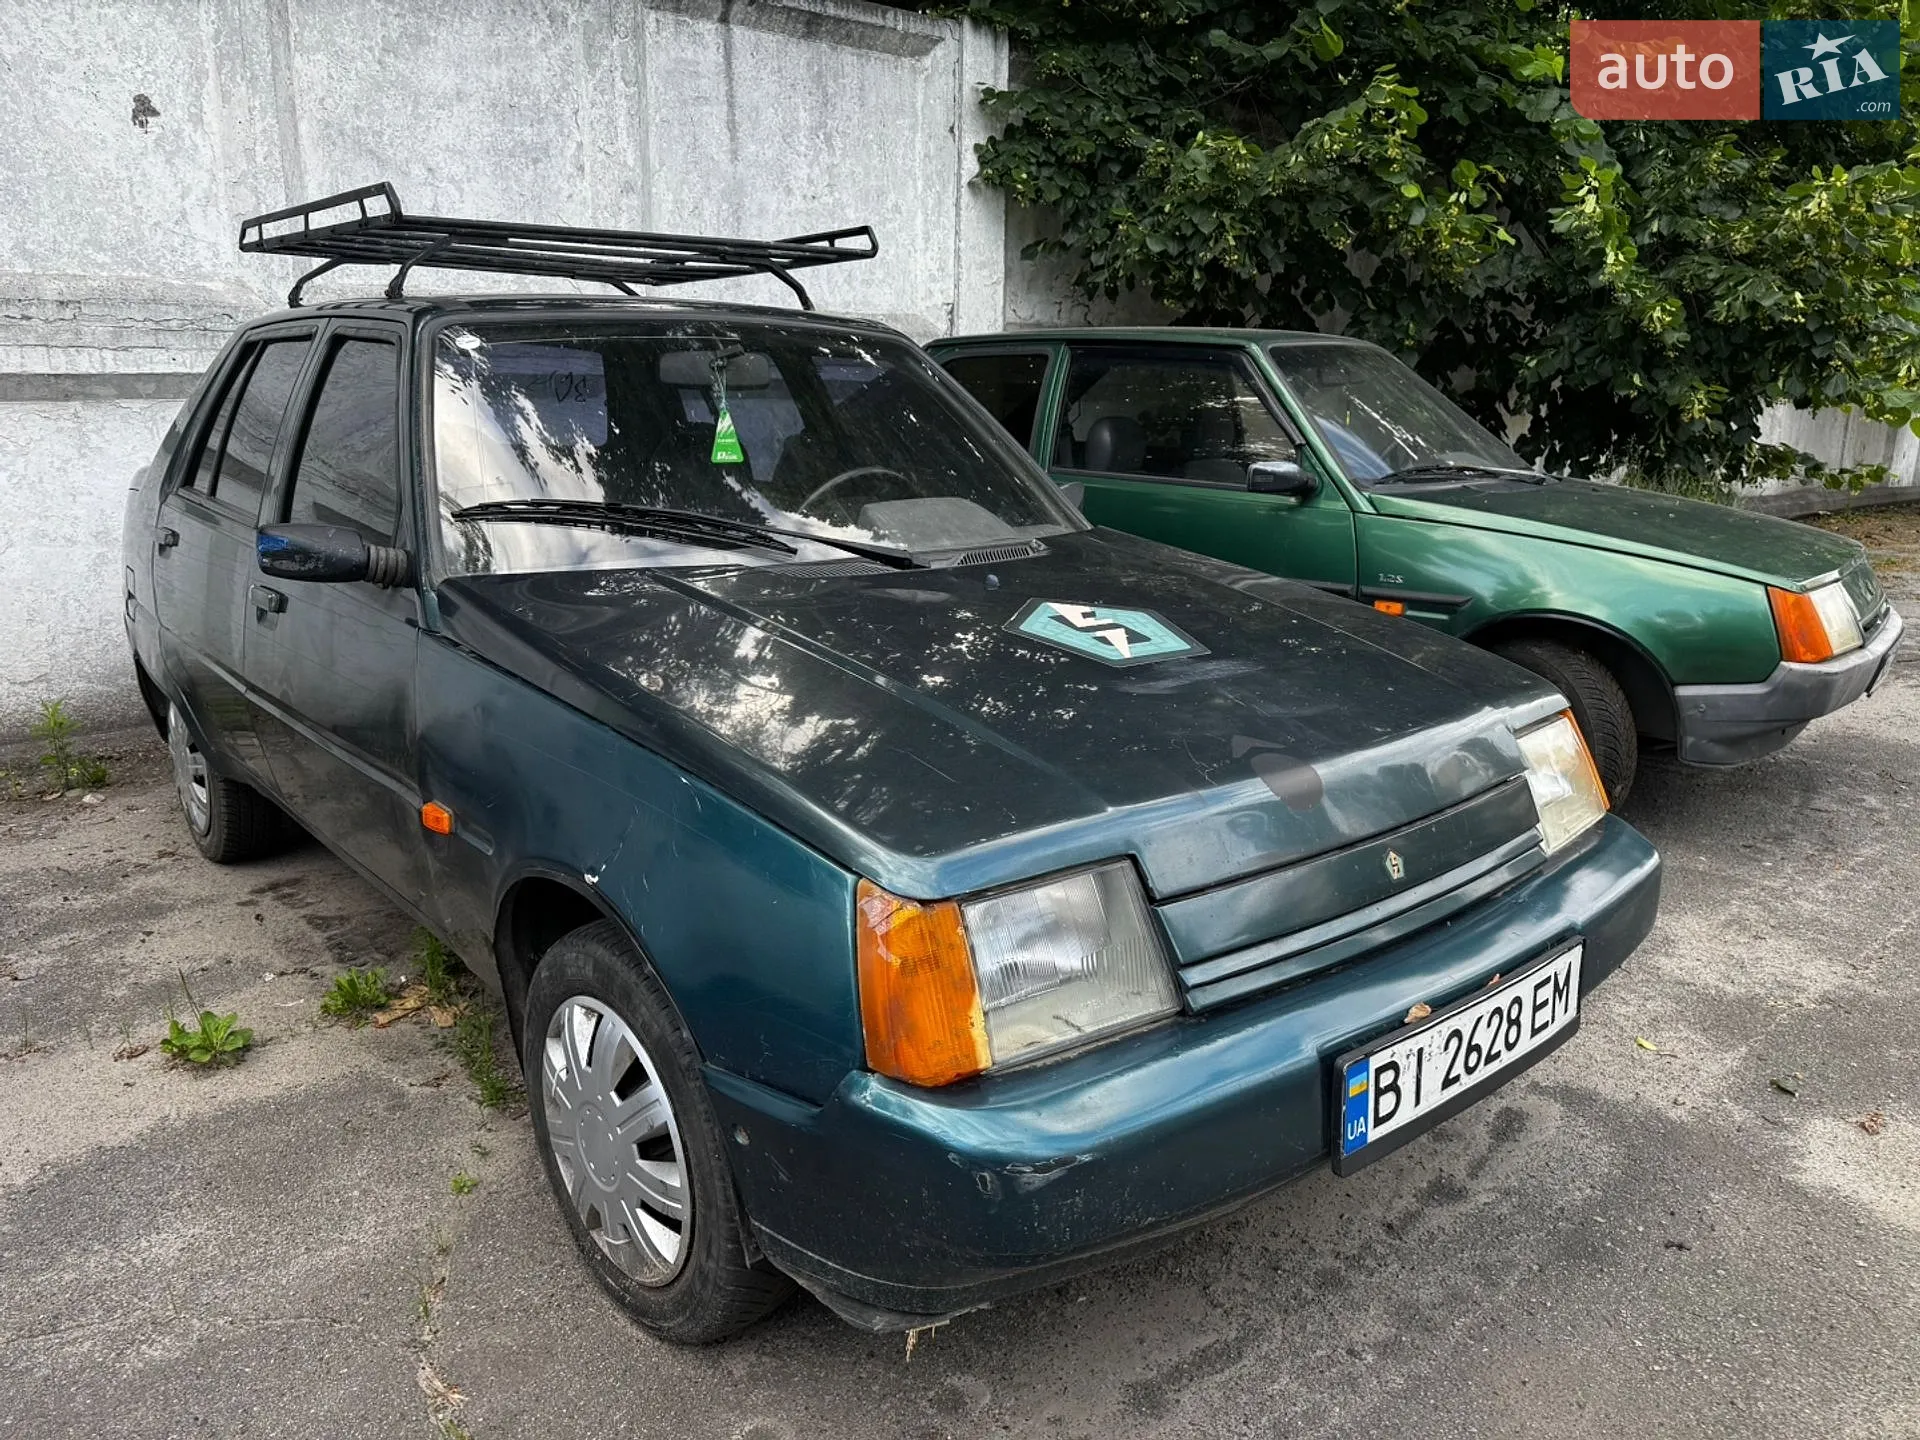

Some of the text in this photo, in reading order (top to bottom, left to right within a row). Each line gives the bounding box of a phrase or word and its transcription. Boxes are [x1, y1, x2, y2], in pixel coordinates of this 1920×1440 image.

[1373, 961, 1572, 1129] BI 2628 EM
[1347, 1116, 1366, 1140] UA
